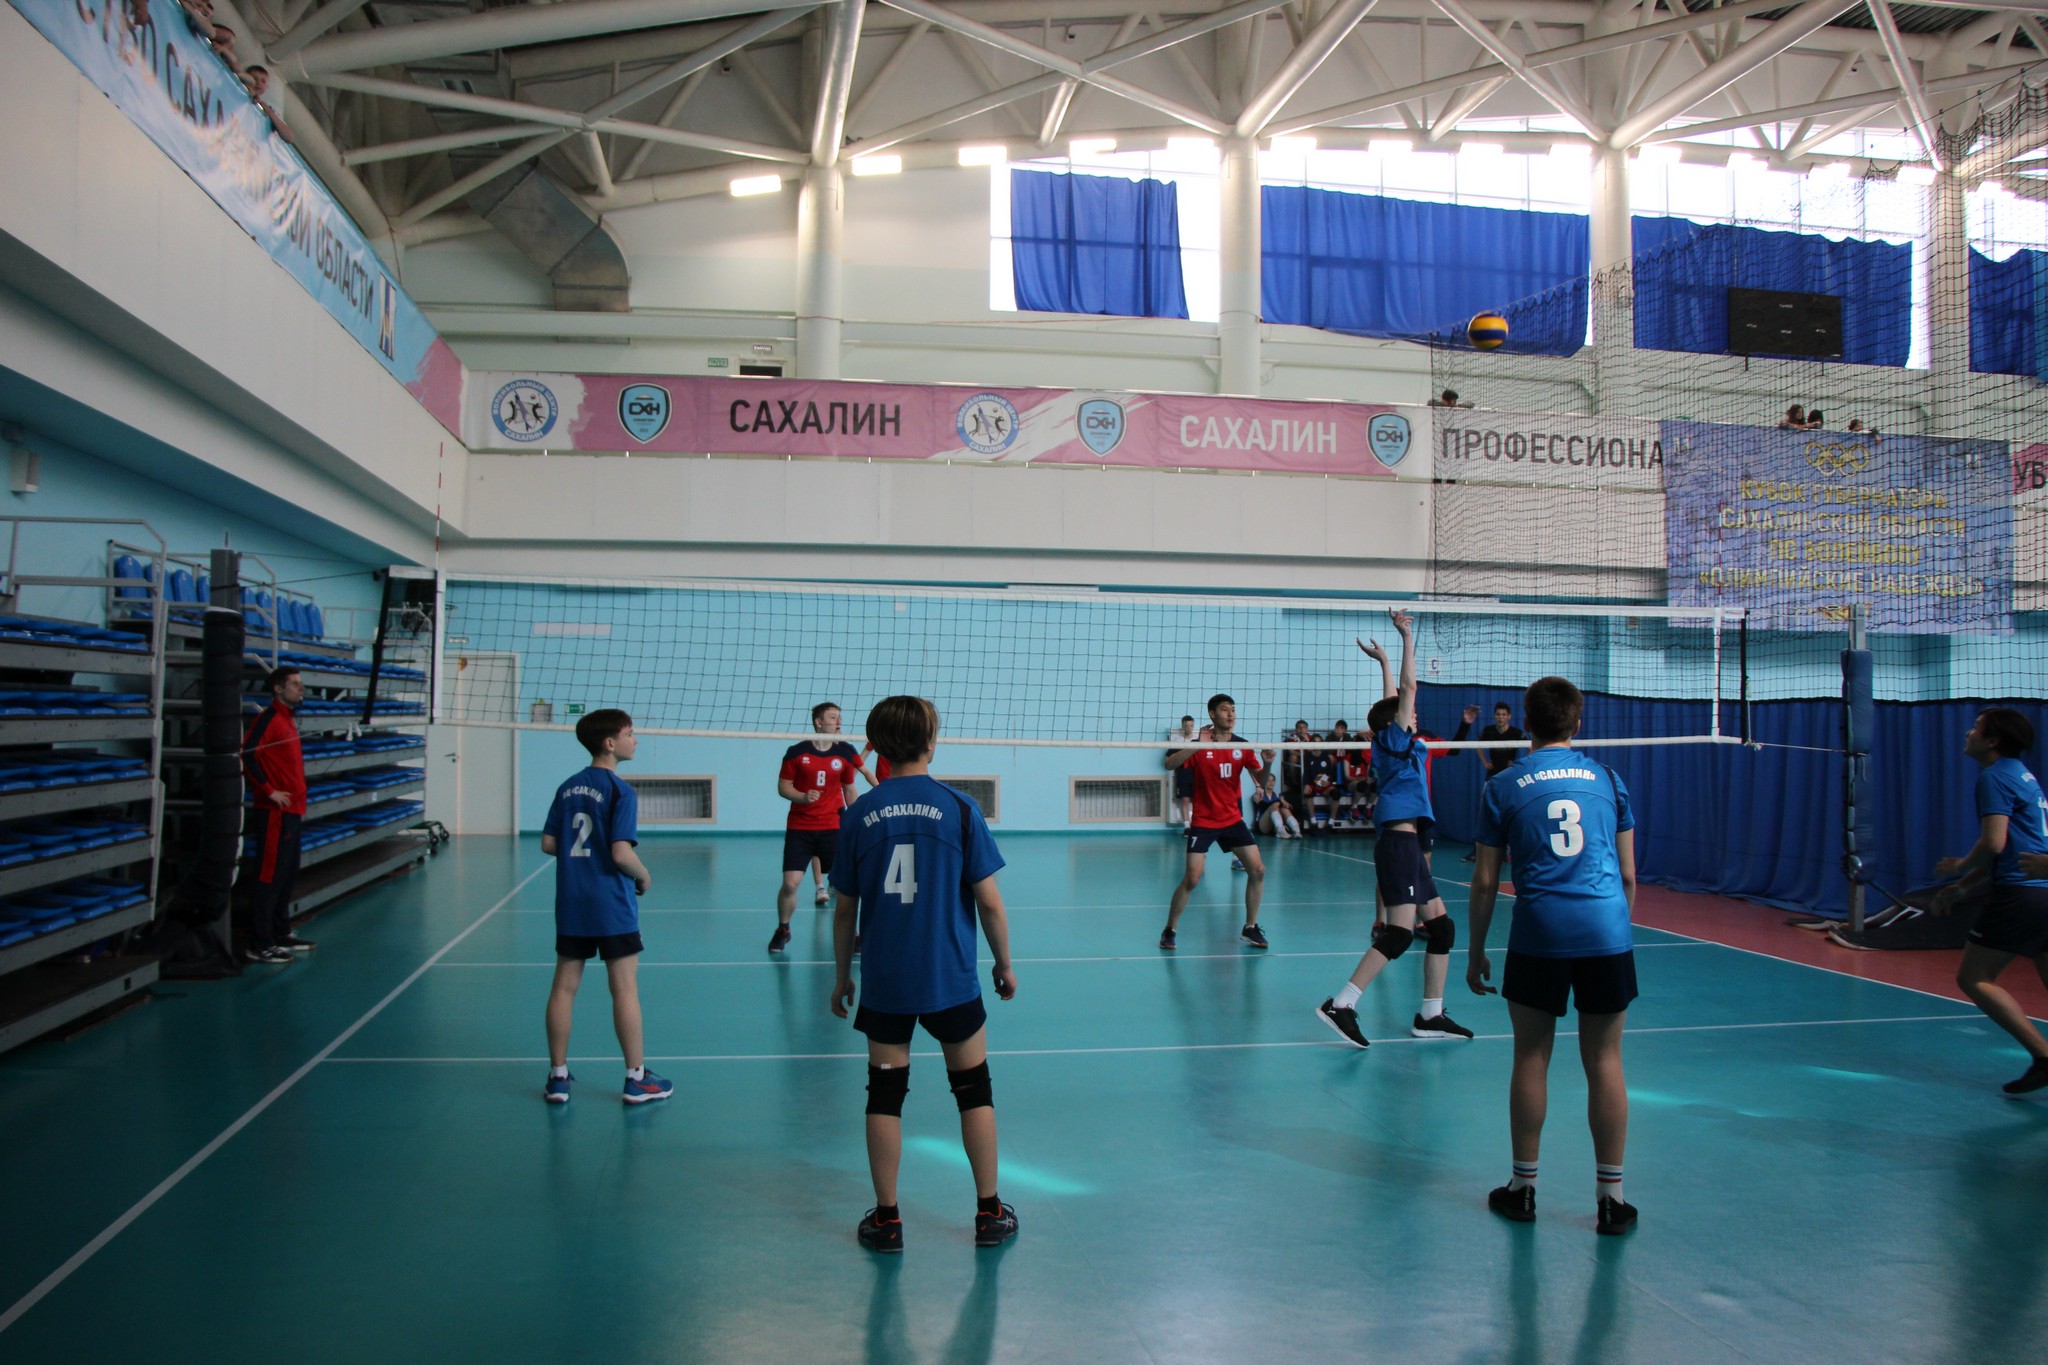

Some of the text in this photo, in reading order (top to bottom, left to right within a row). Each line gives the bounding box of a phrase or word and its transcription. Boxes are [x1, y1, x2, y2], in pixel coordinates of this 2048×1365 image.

[315, 217, 374, 324] ОБЛАСТИ
[730, 399, 900, 437] САХАЛИН
[505, 429, 544, 442] САХАЛИН
[969, 441, 1006, 453] САХАЛИН
[1179, 415, 1337, 454] САХАЛИН
[1442, 428, 1663, 469] ПРОФЕССИОНА
[1740, 480, 1948, 509] КУБОК ГУБЕРНАТОРА
[1722, 507, 1966, 539] САХАЛИНСКОЙ ОБЛАСТИ
[1770, 539, 1920, 565] ПО ВОЛЕЙБОЛУ
[1700, 566, 1984, 597] «ОЛИМПИЙСКИЕ НАДЕЖДЫ»
[817, 770, 826, 786] 8
[1219, 763, 1232, 778] 10
[1516, 768, 1596, 788] ВЦ «САХАЛИН»
[863, 803, 943, 827] ВЦ «САХАЛИН»
[1547, 799, 1584, 857] 3
[570, 812, 593, 857] 2
[1191, 836, 1198, 848] 7
[884, 843, 918, 904] 4
[1408, 885, 1414, 897] 1
